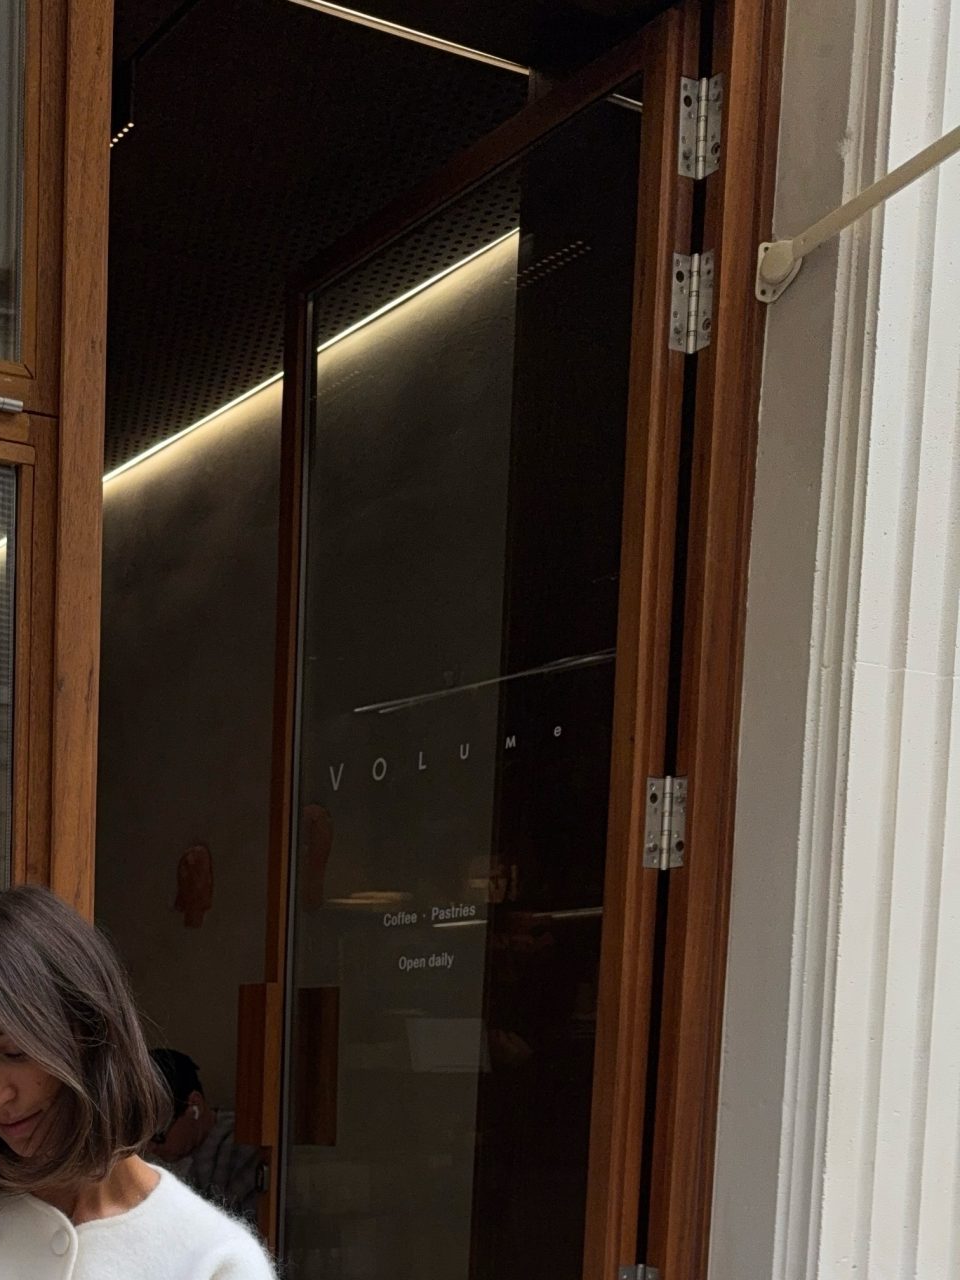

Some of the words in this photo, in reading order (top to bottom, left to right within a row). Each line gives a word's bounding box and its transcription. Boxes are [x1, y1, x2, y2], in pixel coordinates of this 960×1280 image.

[383, 911, 418, 928] Coffee
[431, 903, 476, 921] Pastries
[398, 955, 426, 972] Open
[428, 951, 455, 969] daily
